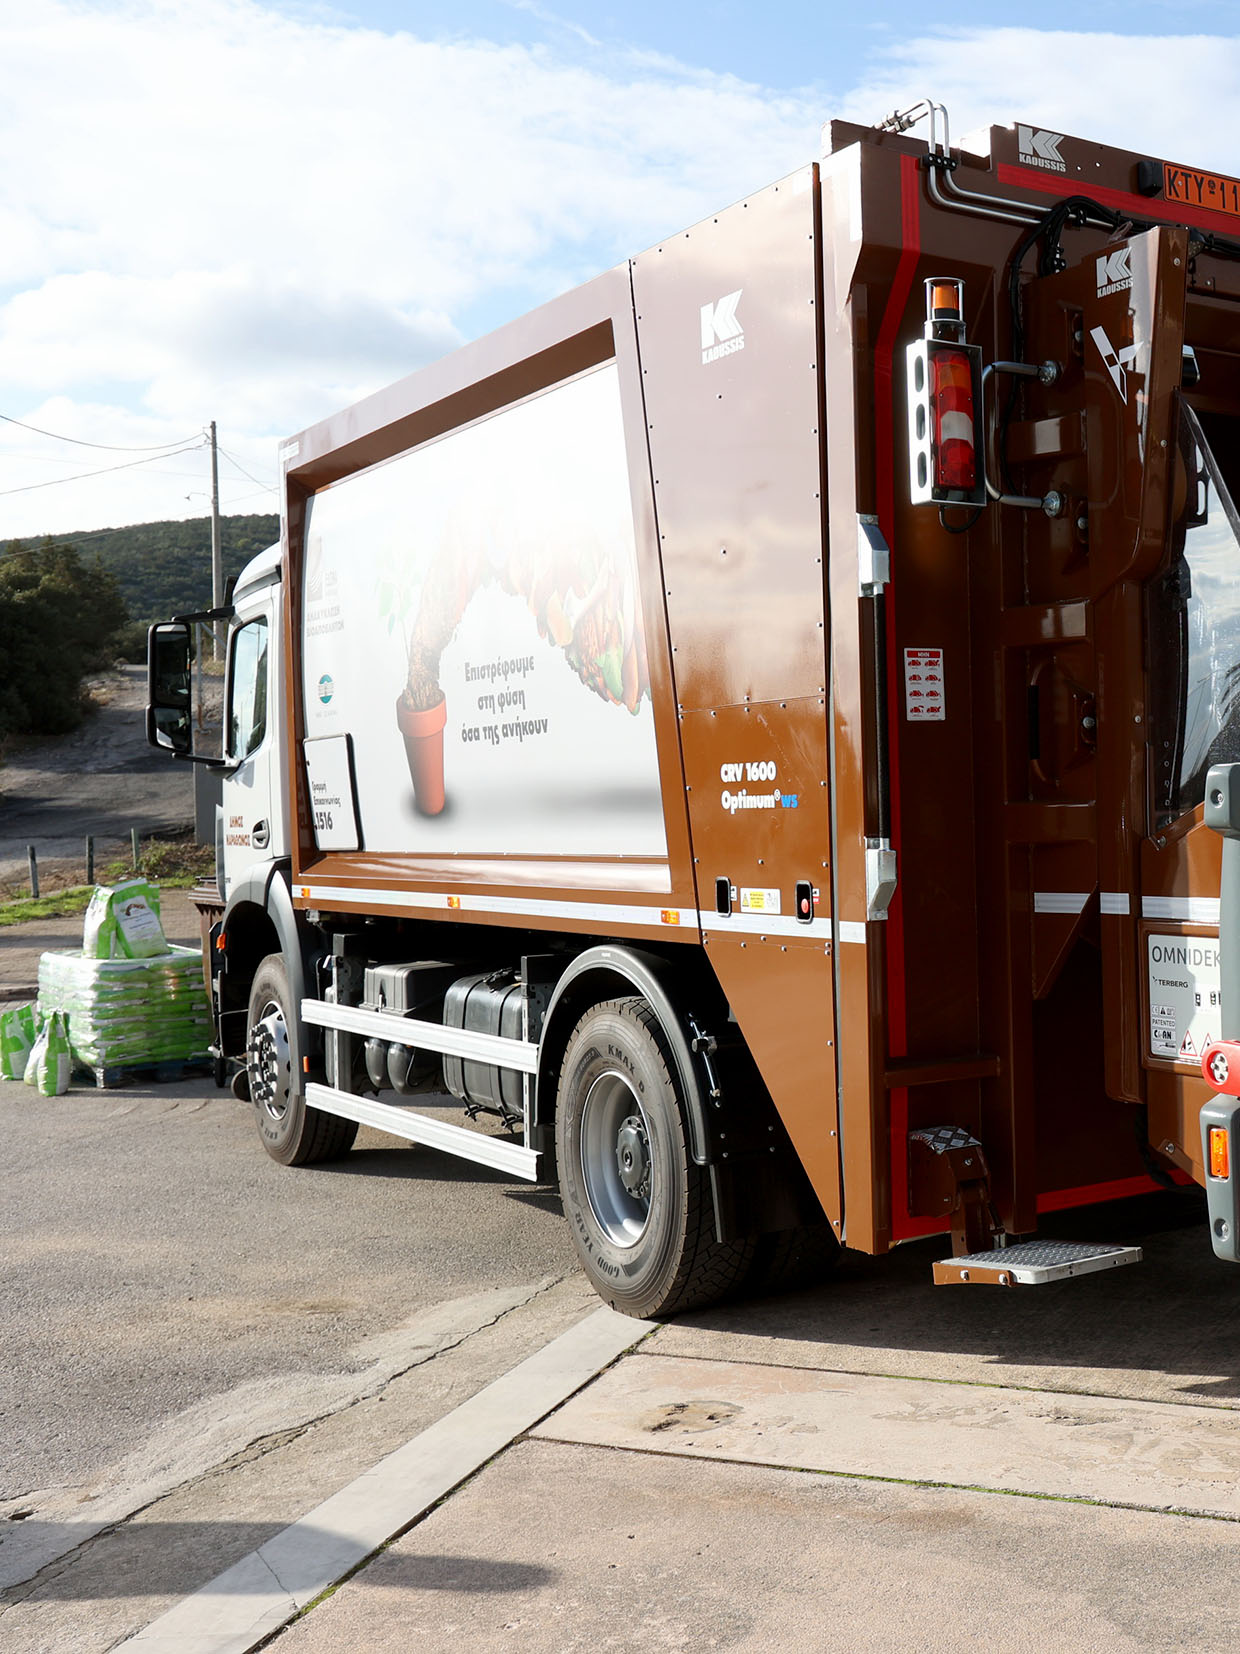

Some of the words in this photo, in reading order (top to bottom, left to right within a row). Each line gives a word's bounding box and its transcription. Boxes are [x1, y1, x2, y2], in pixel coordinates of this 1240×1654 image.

[1019, 153, 1066, 173] KAOUSSIS
[1097, 277, 1134, 299] KAOUSSIS
[702, 334, 745, 365] KAOUSSIS
[464, 656, 535, 684] Επιστρέφουμε
[478, 694, 496, 715] στη
[497, 686, 526, 714] φύση
[461, 723, 480, 742] όσα
[482, 725, 500, 745] της
[501, 716, 548, 743] ανήκουν
[720, 763, 744, 783] CRV
[745, 761, 777, 782] 1600
[1158, 979, 1189, 989] TERBERG
[1152, 1018, 1175, 1028] PATENTED
[607, 1044, 635, 1076] KMAX
